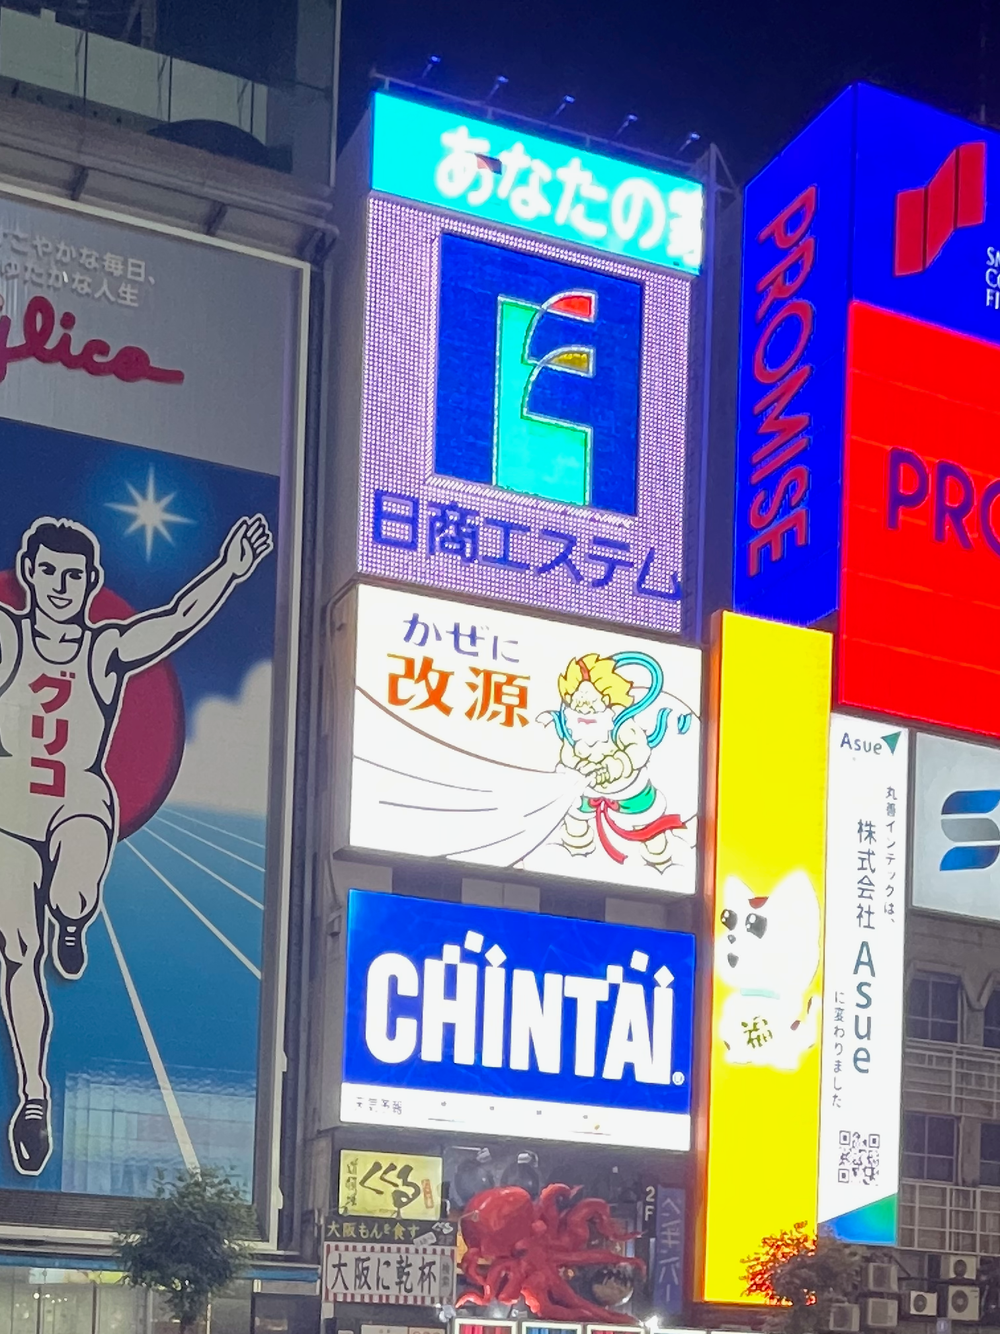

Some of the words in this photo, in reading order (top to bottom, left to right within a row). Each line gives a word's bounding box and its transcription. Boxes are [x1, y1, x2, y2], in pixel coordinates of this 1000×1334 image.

[1, 256, 139, 307] ゆたかな人生
[748, 183, 819, 577] PROMISE
[372, 488, 683, 602] 日商エステム
[402, 612, 520, 664] かぜに
[28, 670, 76, 798] グリコ
[387, 653, 531, 729] 改源
[840, 732, 882, 755] Asue
[856, 818, 877, 930] 株式会社
[832, 991, 845, 1108] に変わりました
[853, 940, 876, 1074] Asue
[359, 1161, 421, 1217] くくる
[330, 1253, 437, 1295] 大阪に乾杯
